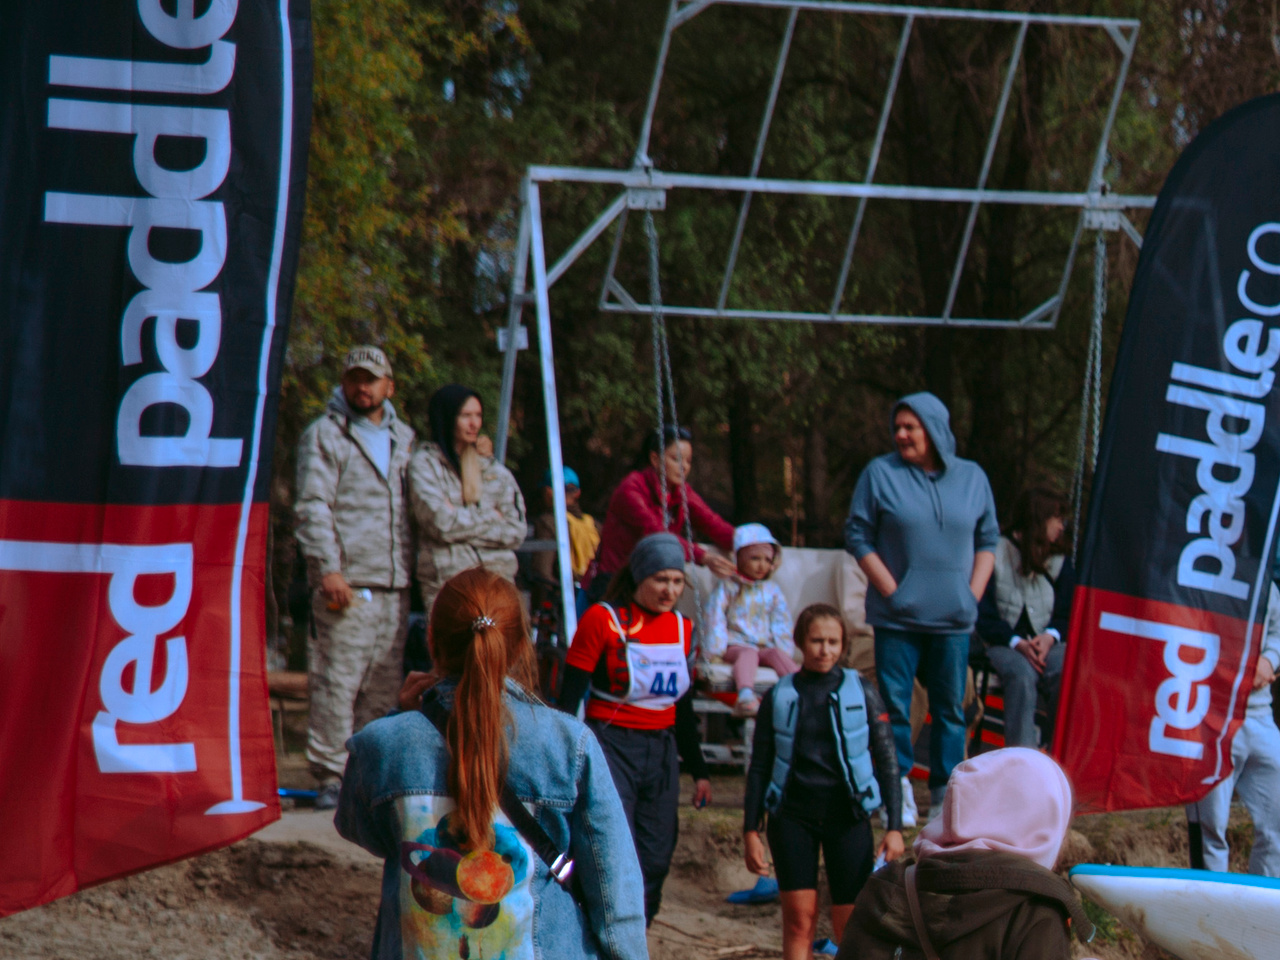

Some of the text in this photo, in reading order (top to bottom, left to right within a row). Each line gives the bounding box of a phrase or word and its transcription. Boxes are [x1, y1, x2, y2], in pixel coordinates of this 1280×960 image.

[0, 540, 197, 773] red
[650, 672, 679, 697] 44
[1100, 612, 1220, 760] red
